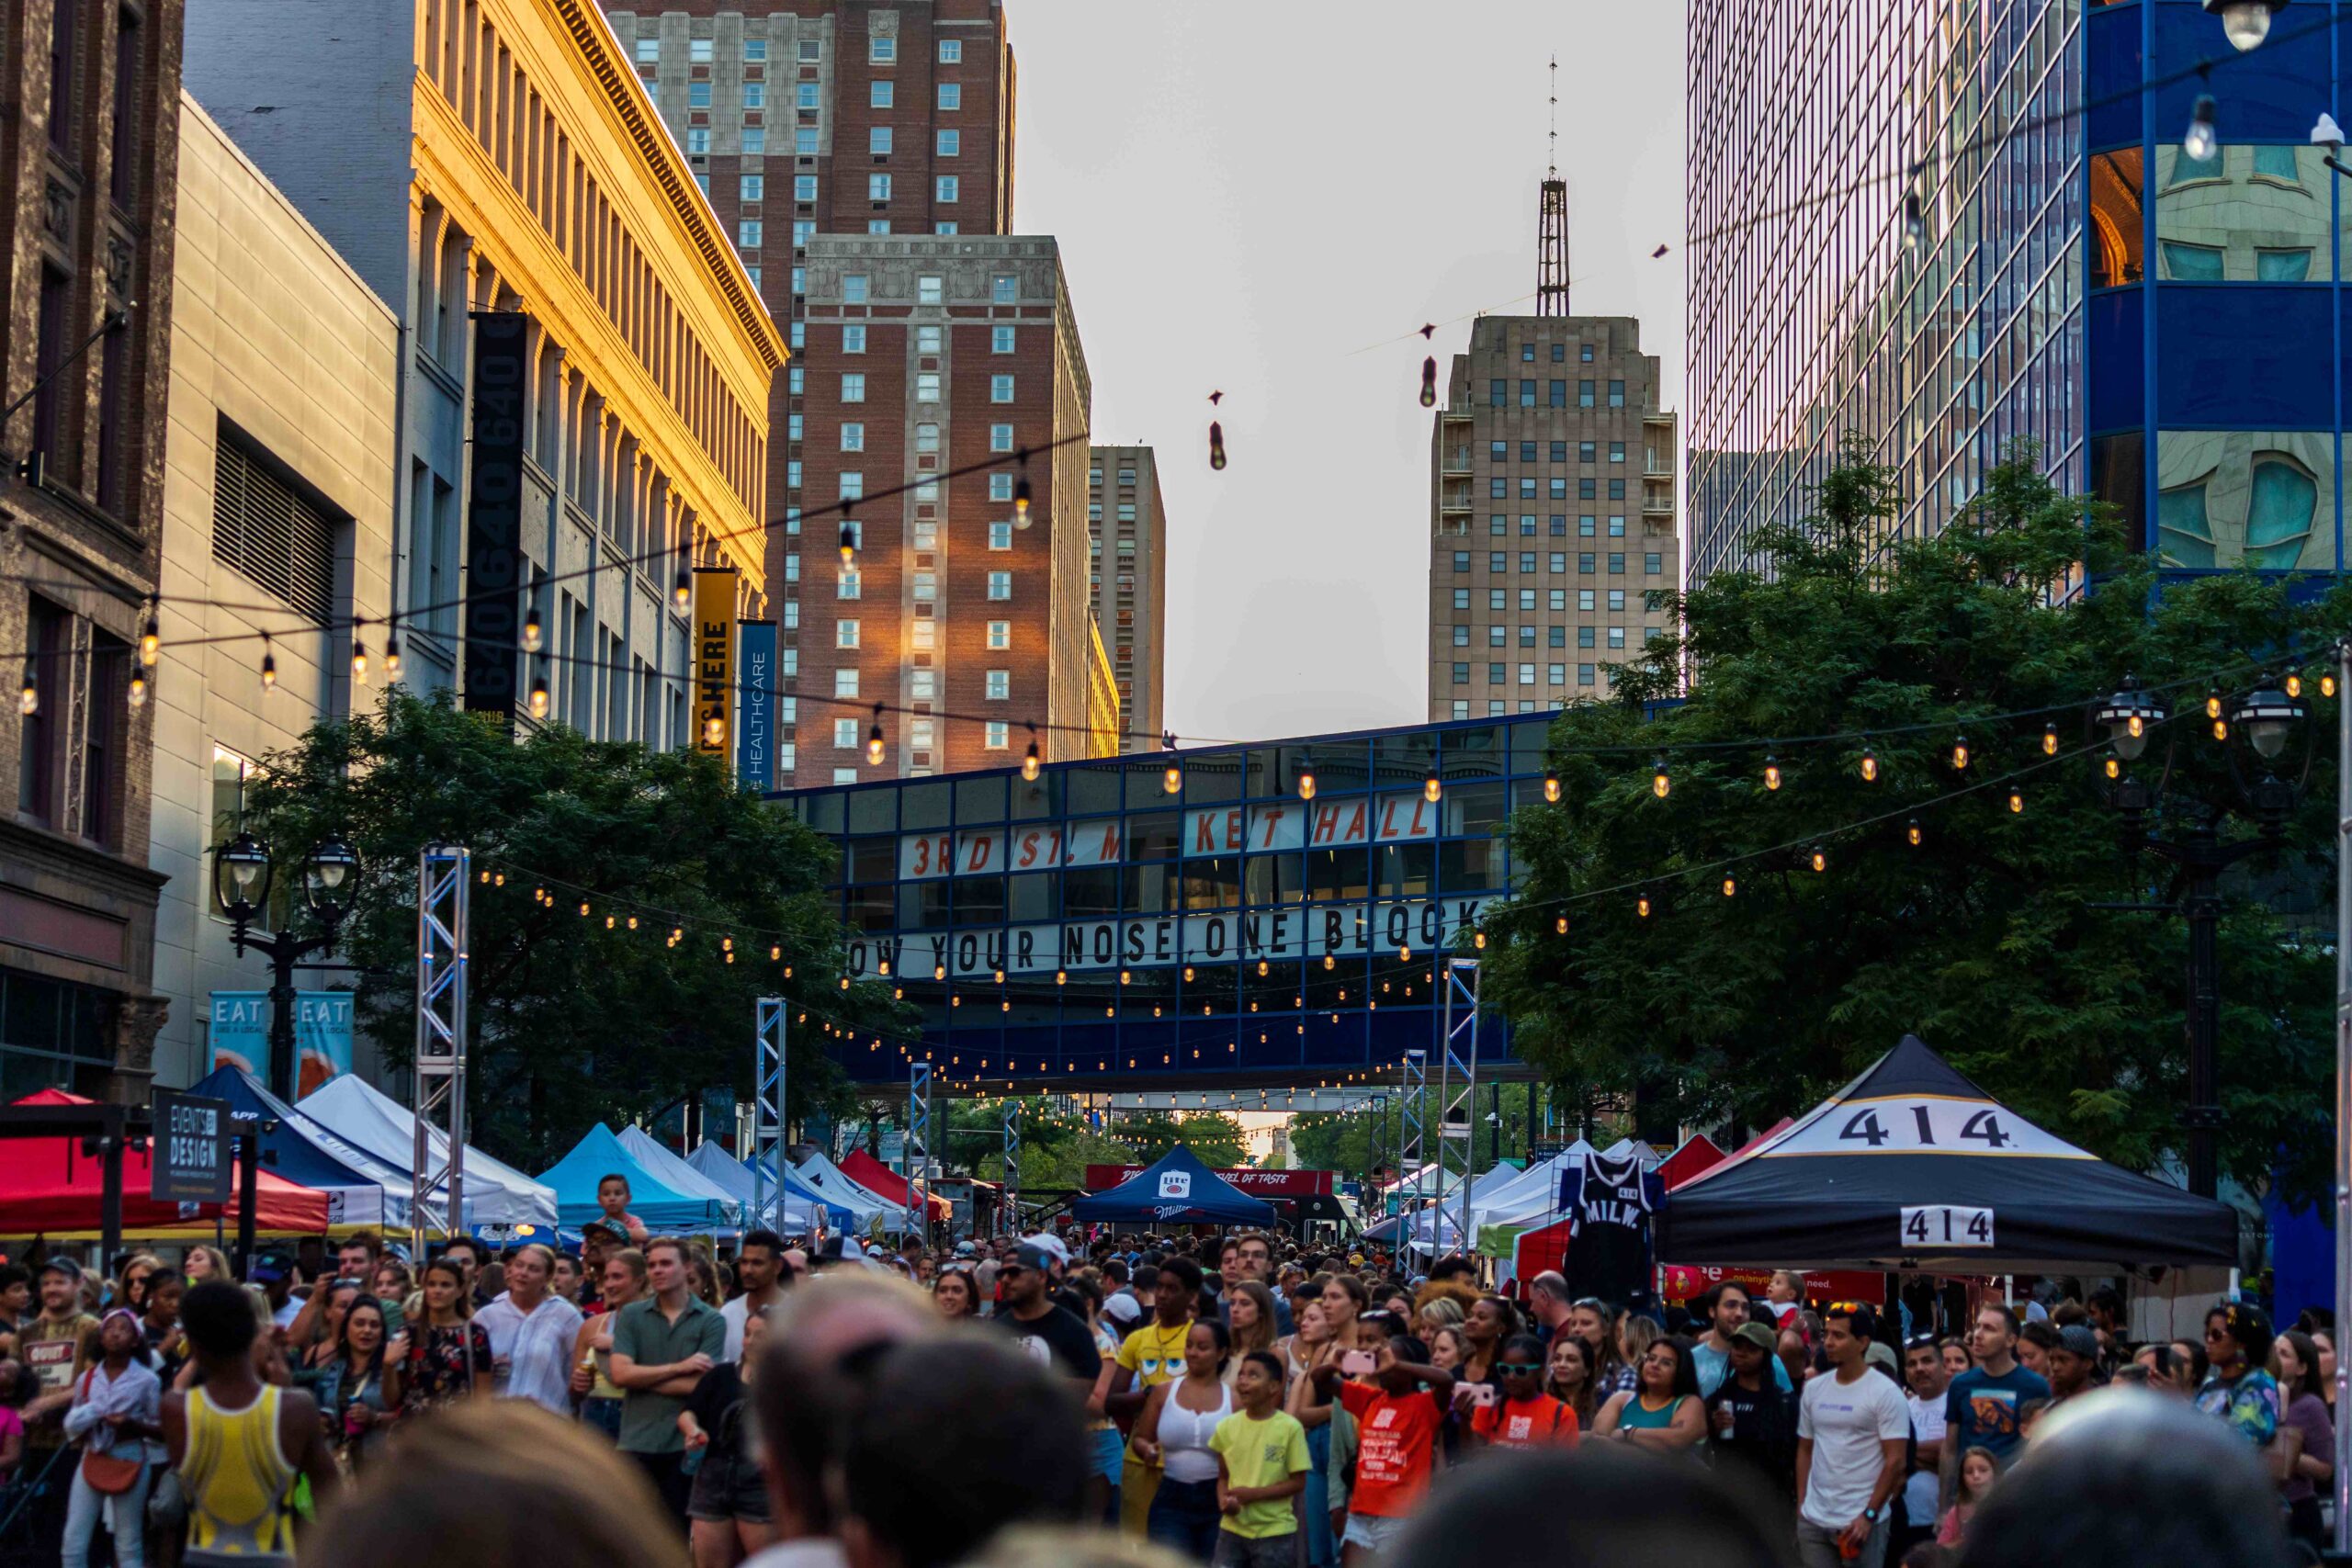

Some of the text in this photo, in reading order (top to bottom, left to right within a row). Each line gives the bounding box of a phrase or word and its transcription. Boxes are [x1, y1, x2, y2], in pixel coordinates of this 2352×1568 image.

[702, 621, 727, 702] HERE
[750, 651, 765, 774] HEALTHCARE
[912, 836, 992, 876] 3RD
[1313, 798, 1428, 843] HALL
[848, 900, 1479, 977] OW YOUR NOSE ONE BLOCK
[215, 1000, 262, 1022] EAT
[300, 1001, 347, 1022] EAT
[170, 1104, 207, 1135] EVENTS
[170, 1136, 218, 1168] DESIGN
[1241, 1174, 1257, 1183] OF
[1258, 1173, 1290, 1184] TASTE
[1154, 1204, 1193, 1221] Miller
[1585, 1200, 1641, 1229] MILW.
[1806, 1280, 1832, 1289] need.
